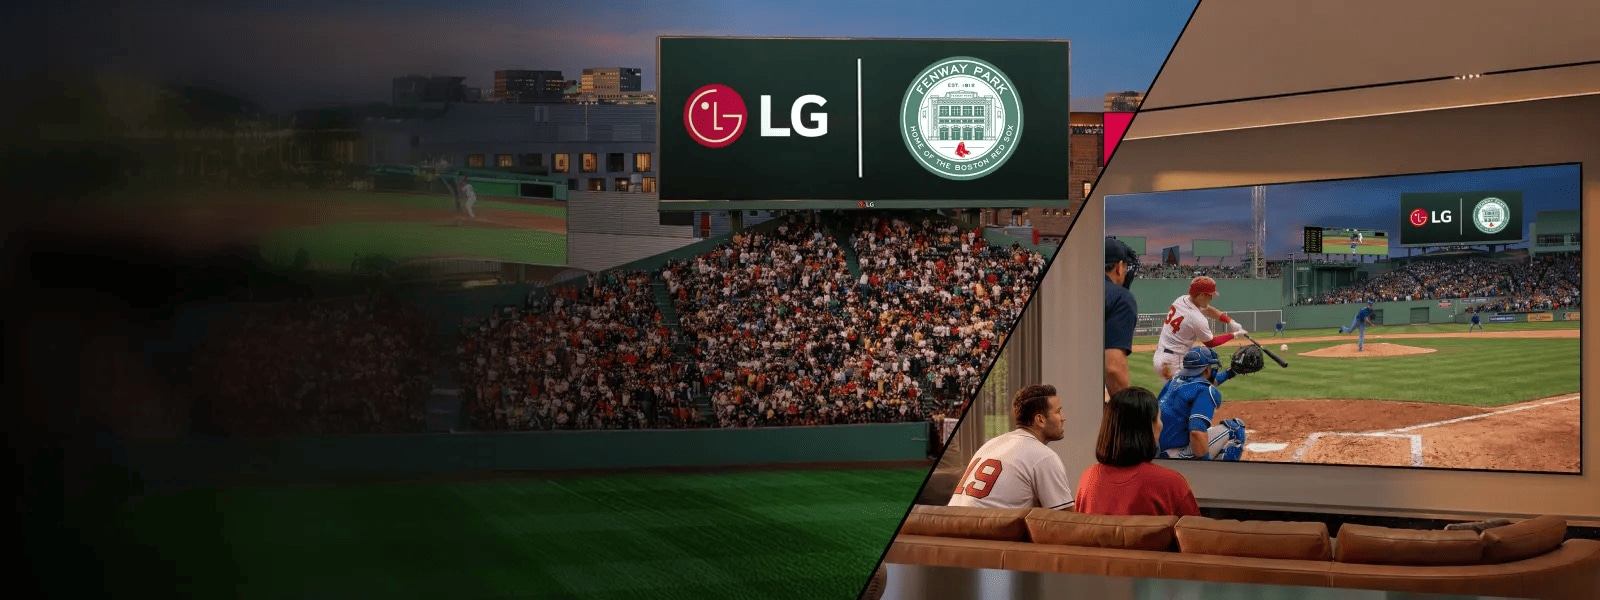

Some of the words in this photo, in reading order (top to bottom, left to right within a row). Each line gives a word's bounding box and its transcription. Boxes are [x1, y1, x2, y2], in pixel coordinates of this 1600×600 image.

[916, 64, 968, 95] FENWAY
[973, 66, 1008, 95] PARK
[760, 94, 828, 137] LG
[910, 125, 924, 149] HOME
[923, 150, 935, 160] OF
[936, 159, 952, 170] THE
[954, 158, 990, 171] BOSTON
[991, 144, 1006, 160] RED
[1003, 124, 1014, 143] SOX
[1431, 209, 1452, 224] LG
[1165, 304, 1185, 334] 34
[953, 457, 1003, 500] 19
